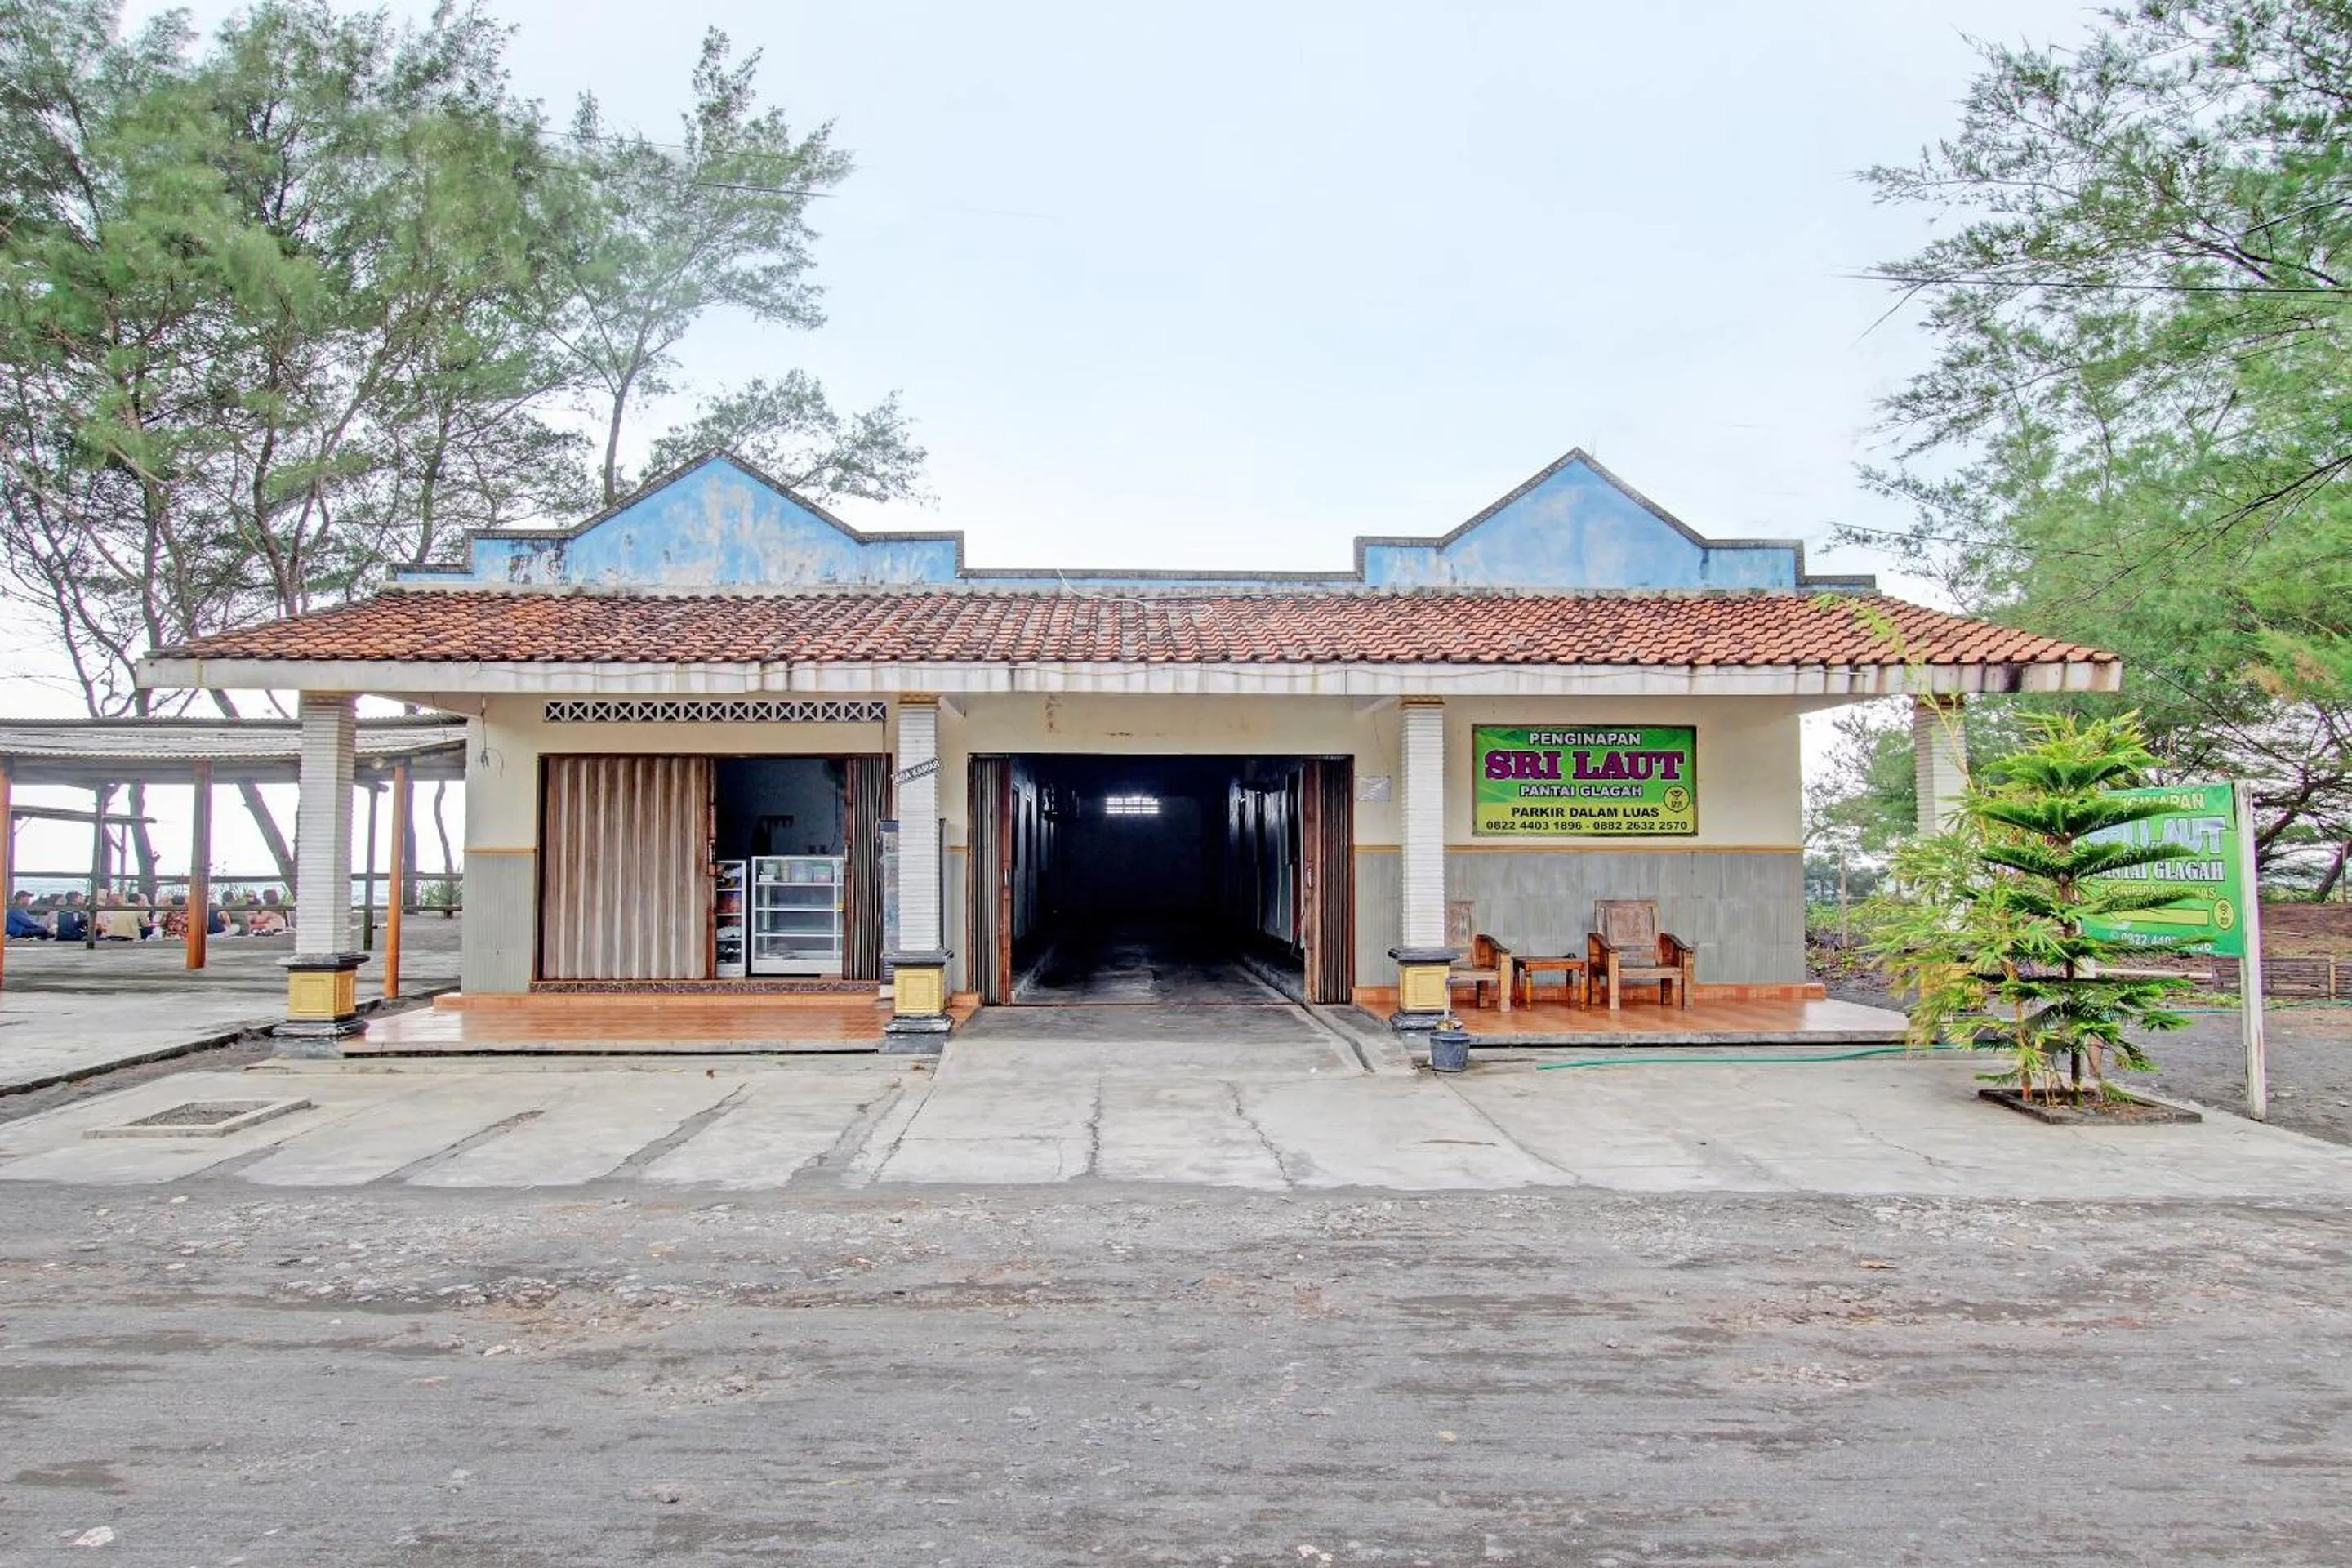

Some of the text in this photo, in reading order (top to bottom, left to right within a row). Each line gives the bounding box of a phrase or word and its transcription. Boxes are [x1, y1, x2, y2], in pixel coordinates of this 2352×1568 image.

[1529, 733, 1642, 746] PENGINAPAN
[1484, 751, 1686, 780] SRI LAUT
[1520, 785, 1643, 797] PANTAI GLAGAH
[1512, 807, 1659, 817] PARKIR DALAM LUAS
[1486, 821, 1517, 830] 0822
[1519, 821, 1549, 830] 4403
[1553, 821, 1583, 830] 1896
[1592, 821, 1622, 830] 0882
[1626, 821, 1655, 830] 2632
[1659, 821, 1688, 830] 2570
[2153, 860, 2225, 881] GLAGAH
